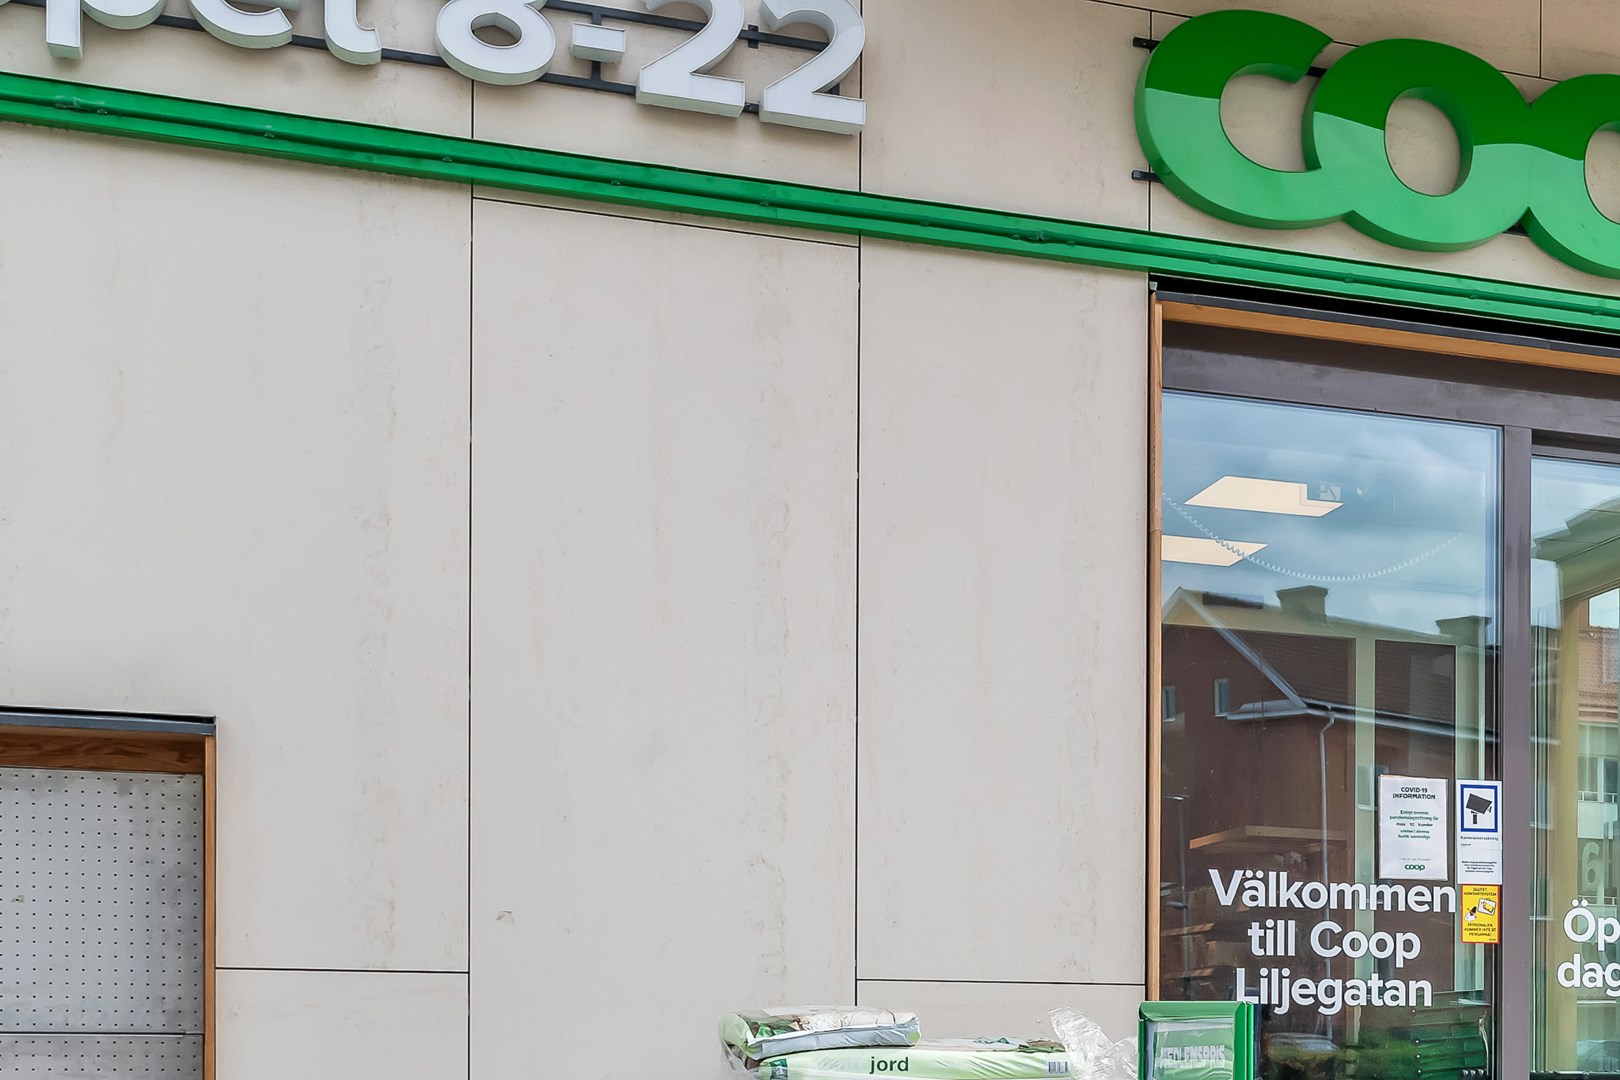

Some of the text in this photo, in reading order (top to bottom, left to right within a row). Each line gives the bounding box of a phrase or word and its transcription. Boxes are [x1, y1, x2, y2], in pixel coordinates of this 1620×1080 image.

[1208, 868, 1456, 913] Välkommen
[1248, 919, 1421, 968] till Coop
[1236, 967, 1432, 1016] Liljegatan
